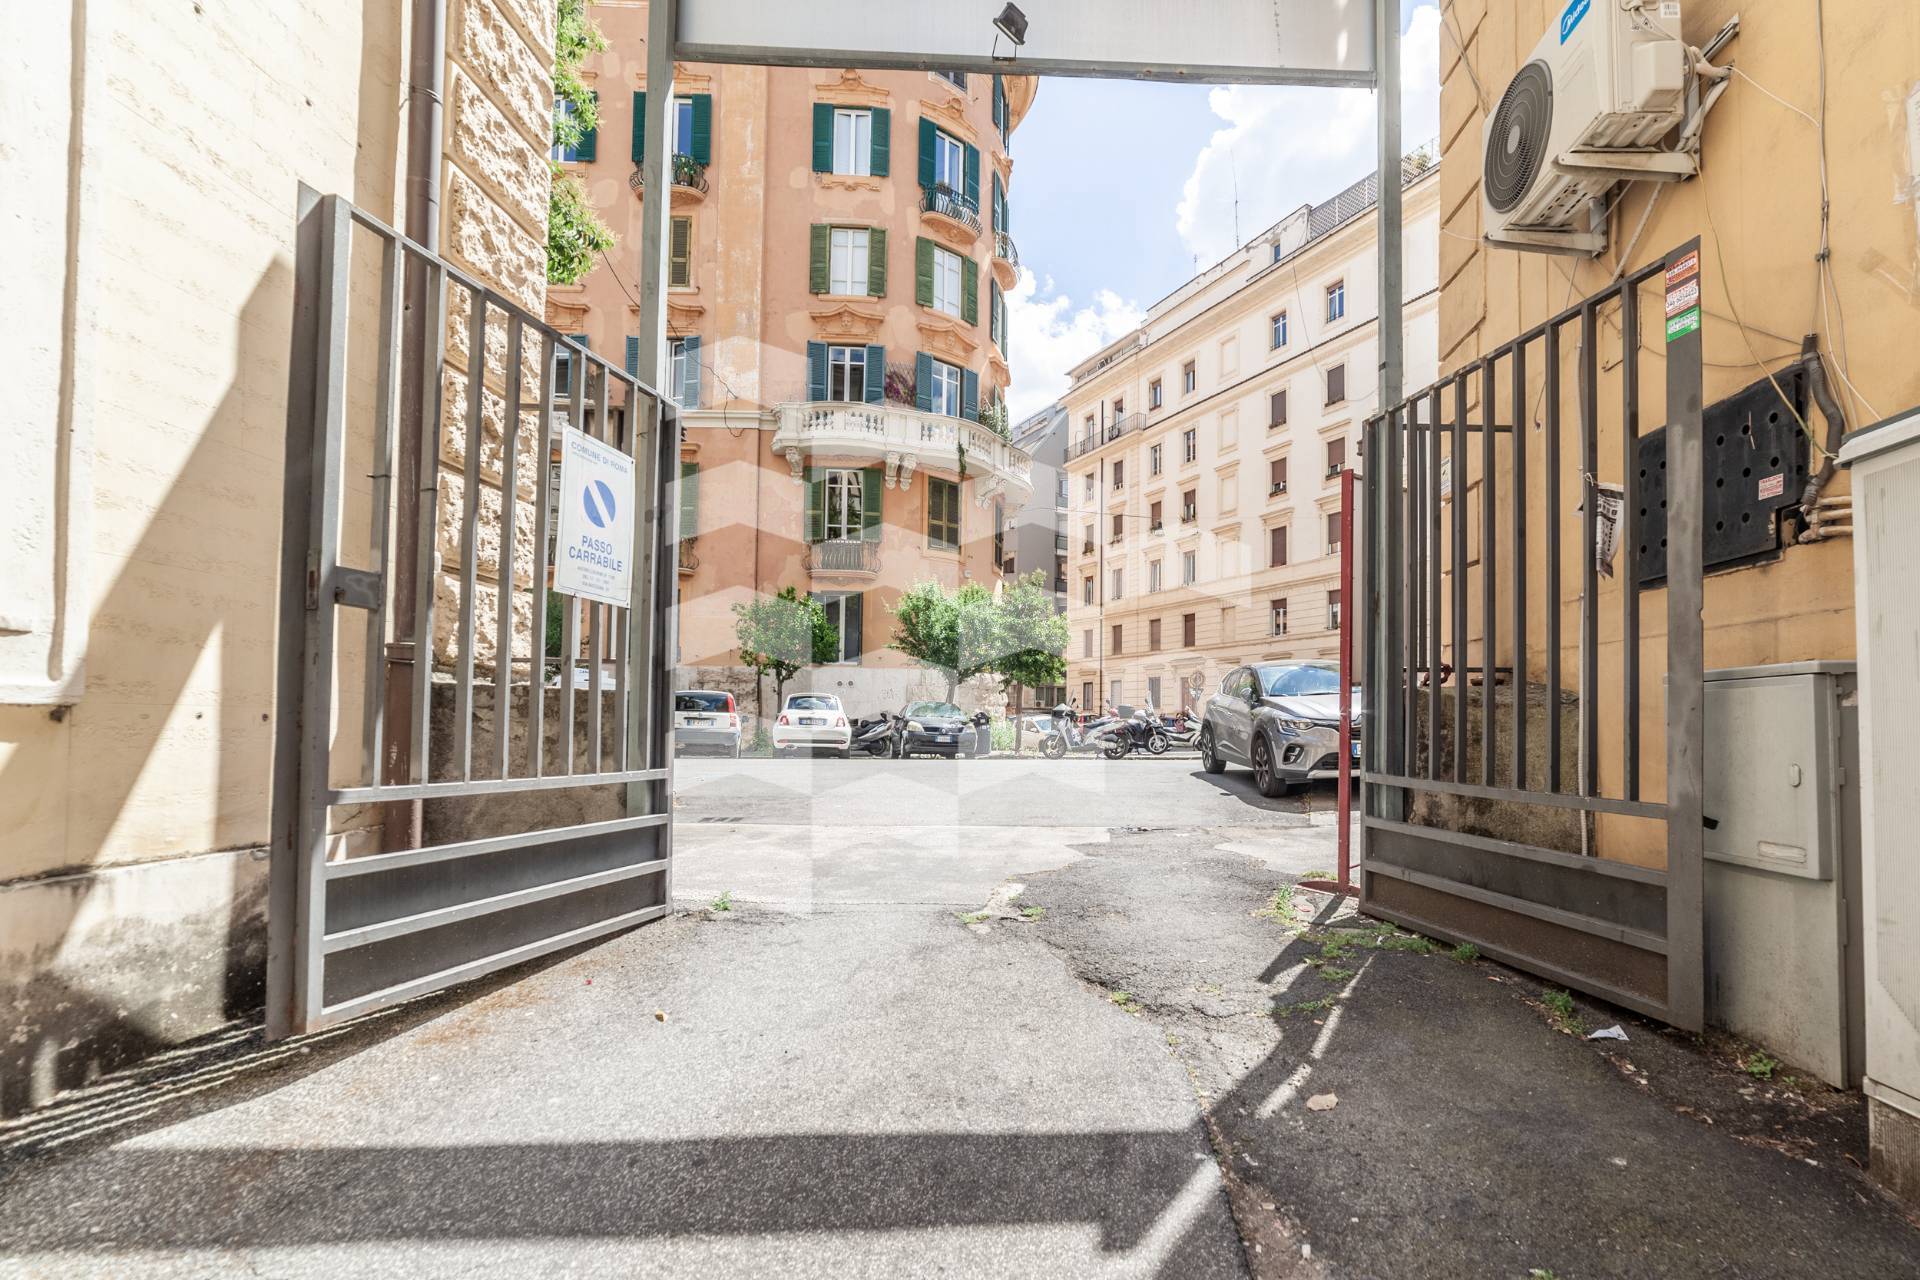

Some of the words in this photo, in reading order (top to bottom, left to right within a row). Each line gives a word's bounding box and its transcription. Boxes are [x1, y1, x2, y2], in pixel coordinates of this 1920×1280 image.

[571, 441, 600, 462] COMUNE
[602, 456, 609, 465] DI
[610, 460, 628, 473] ROMA
[568, 545, 623, 572] CARRABILE
[582, 535, 613, 556] PASSO
